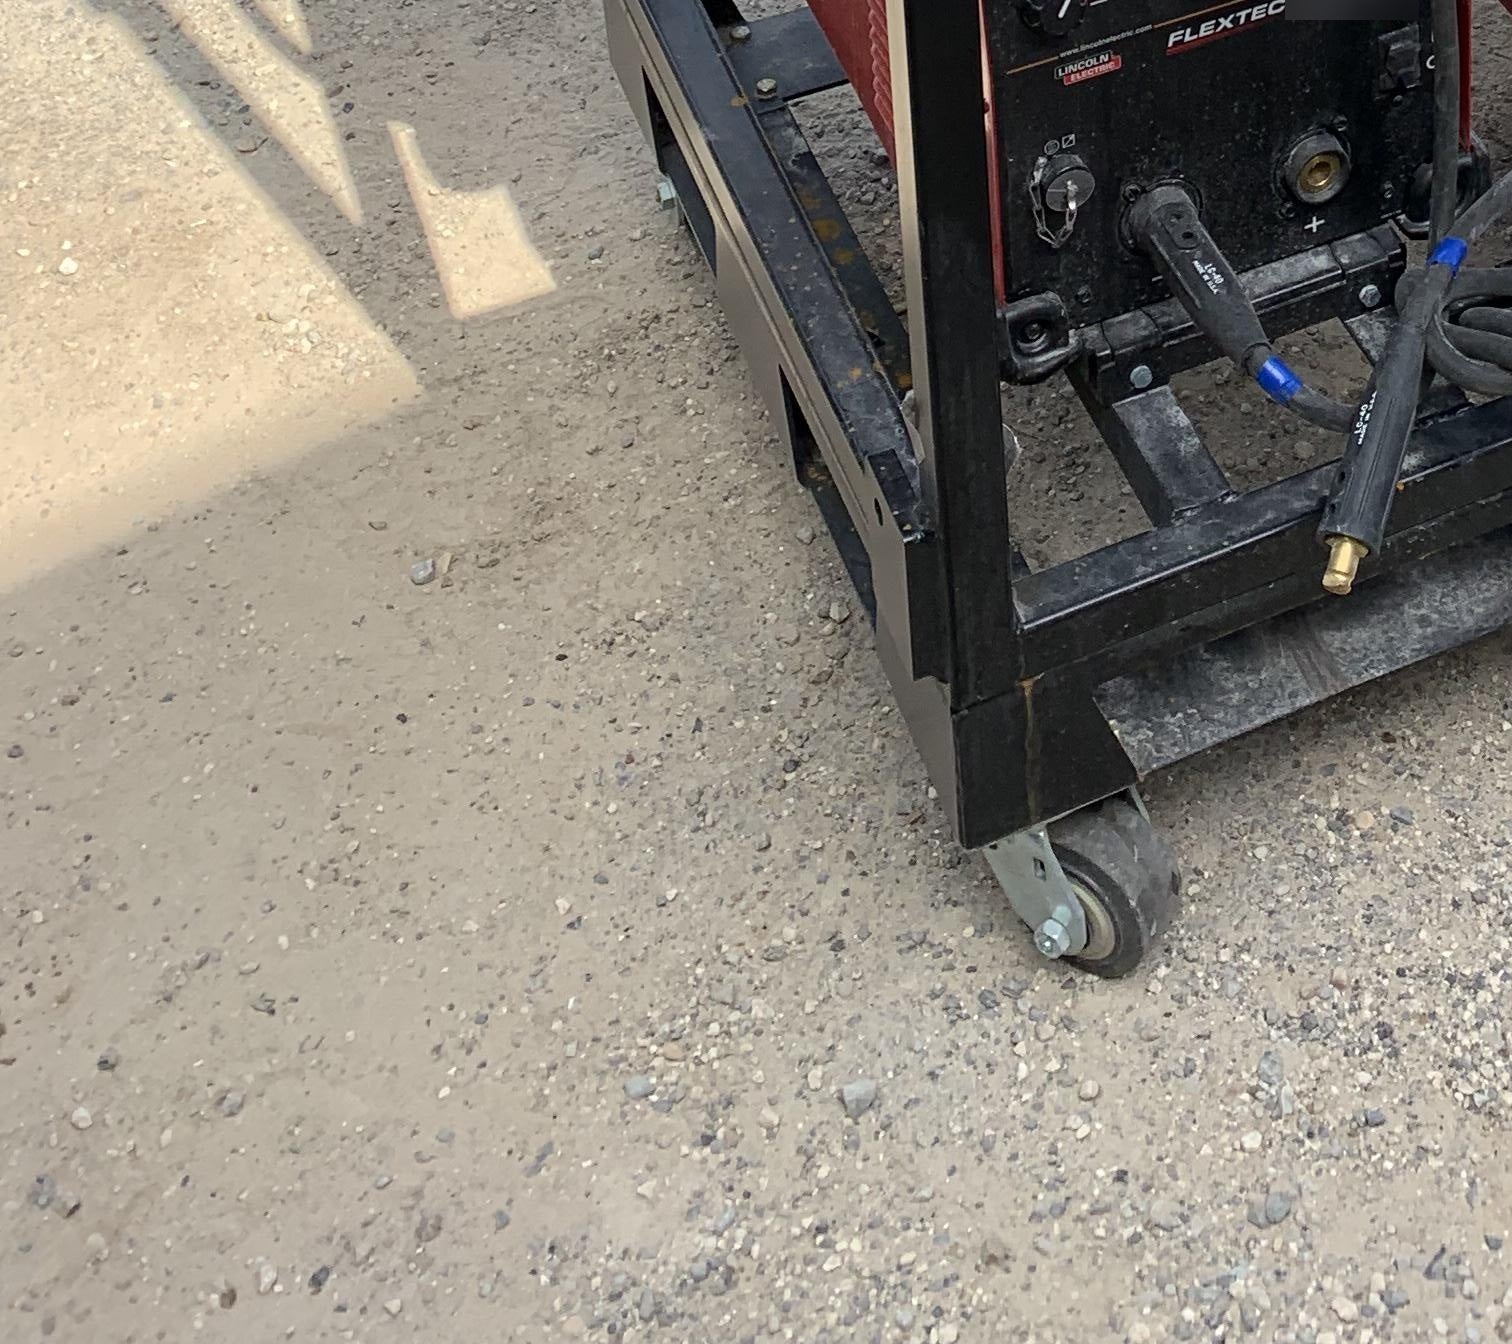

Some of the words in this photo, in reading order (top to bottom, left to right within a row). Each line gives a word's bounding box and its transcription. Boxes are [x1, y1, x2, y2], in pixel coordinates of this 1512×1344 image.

[1059, 24, 1153, 58] www.lincolnelectric.com
[1058, 52, 1110, 77] LINCOLN
[1070, 61, 1116, 82] ELECTRIC
[1204, 263, 1225, 284] LC-40
[1353, 404, 1368, 435] LC-40
[1357, 423, 1368, 445] MADE
